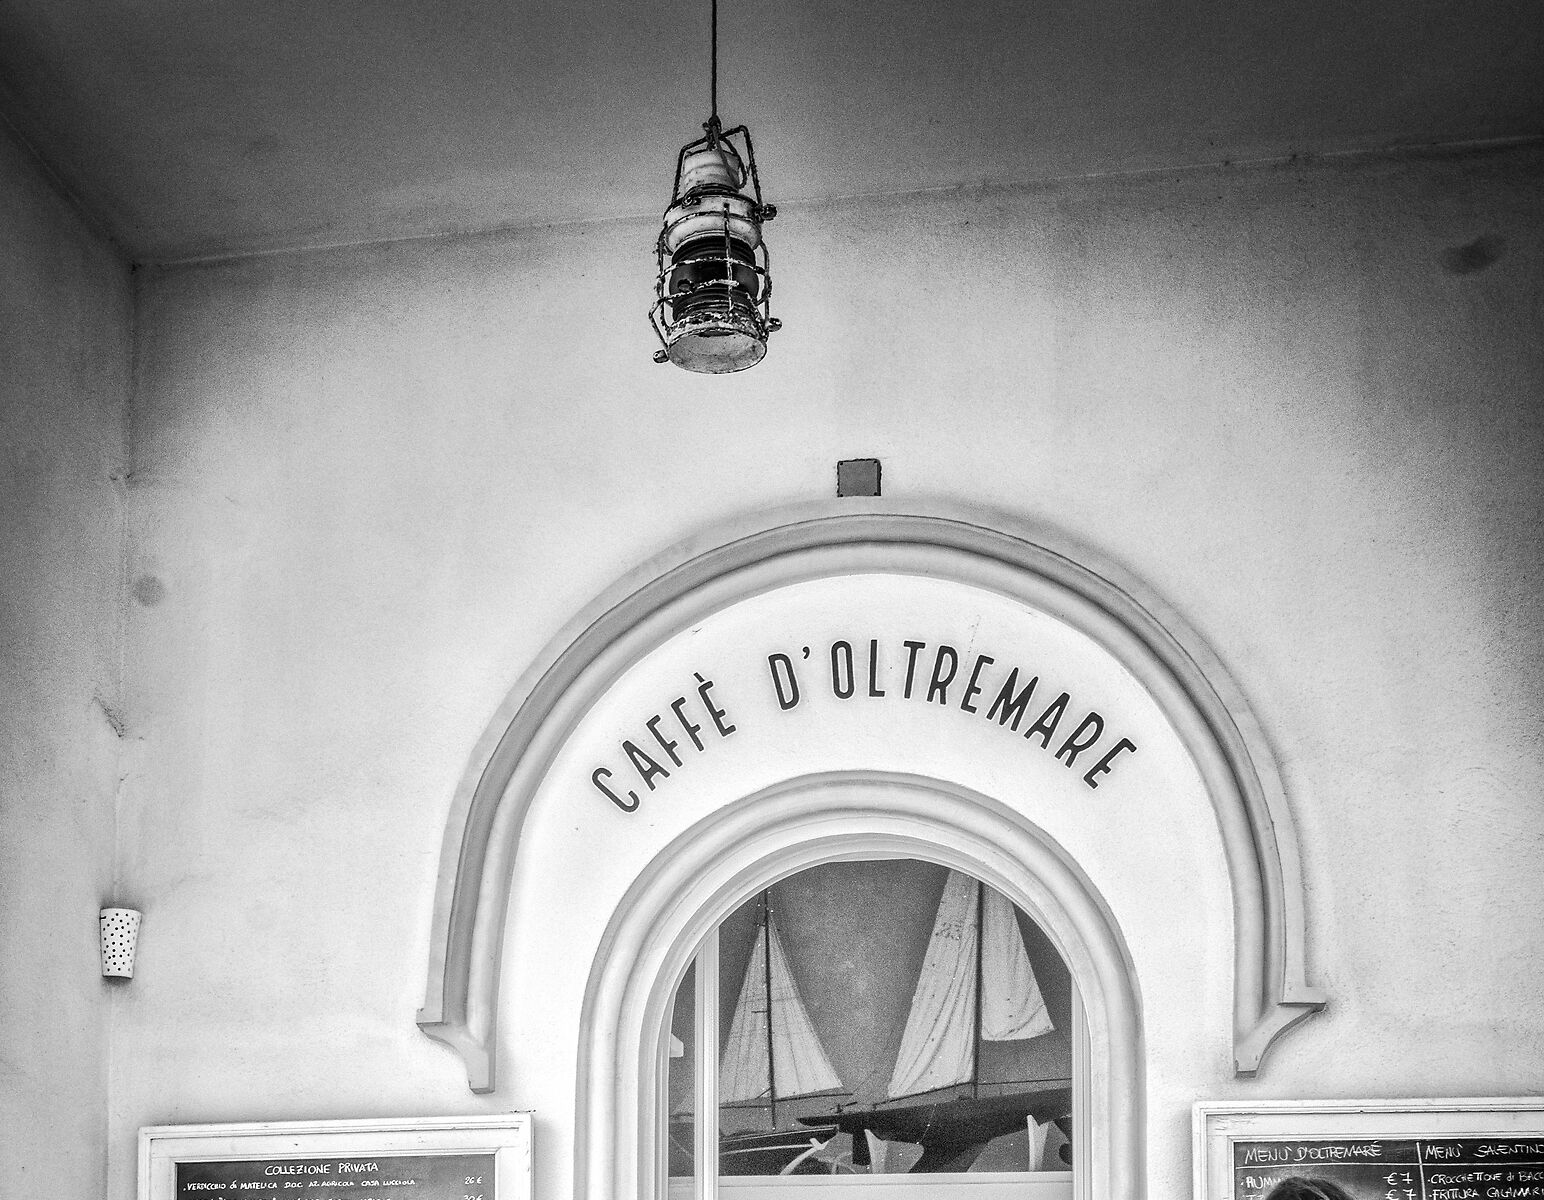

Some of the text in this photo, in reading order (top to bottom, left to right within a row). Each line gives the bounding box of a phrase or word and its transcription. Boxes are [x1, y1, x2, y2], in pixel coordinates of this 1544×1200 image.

[591, 638, 1138, 814] CAFFÈ D'OLTREMARE
[264, 1162, 379, 1176] COLLEZIONE PRIVATA
[240, 1182, 278, 1190] MATELICA
